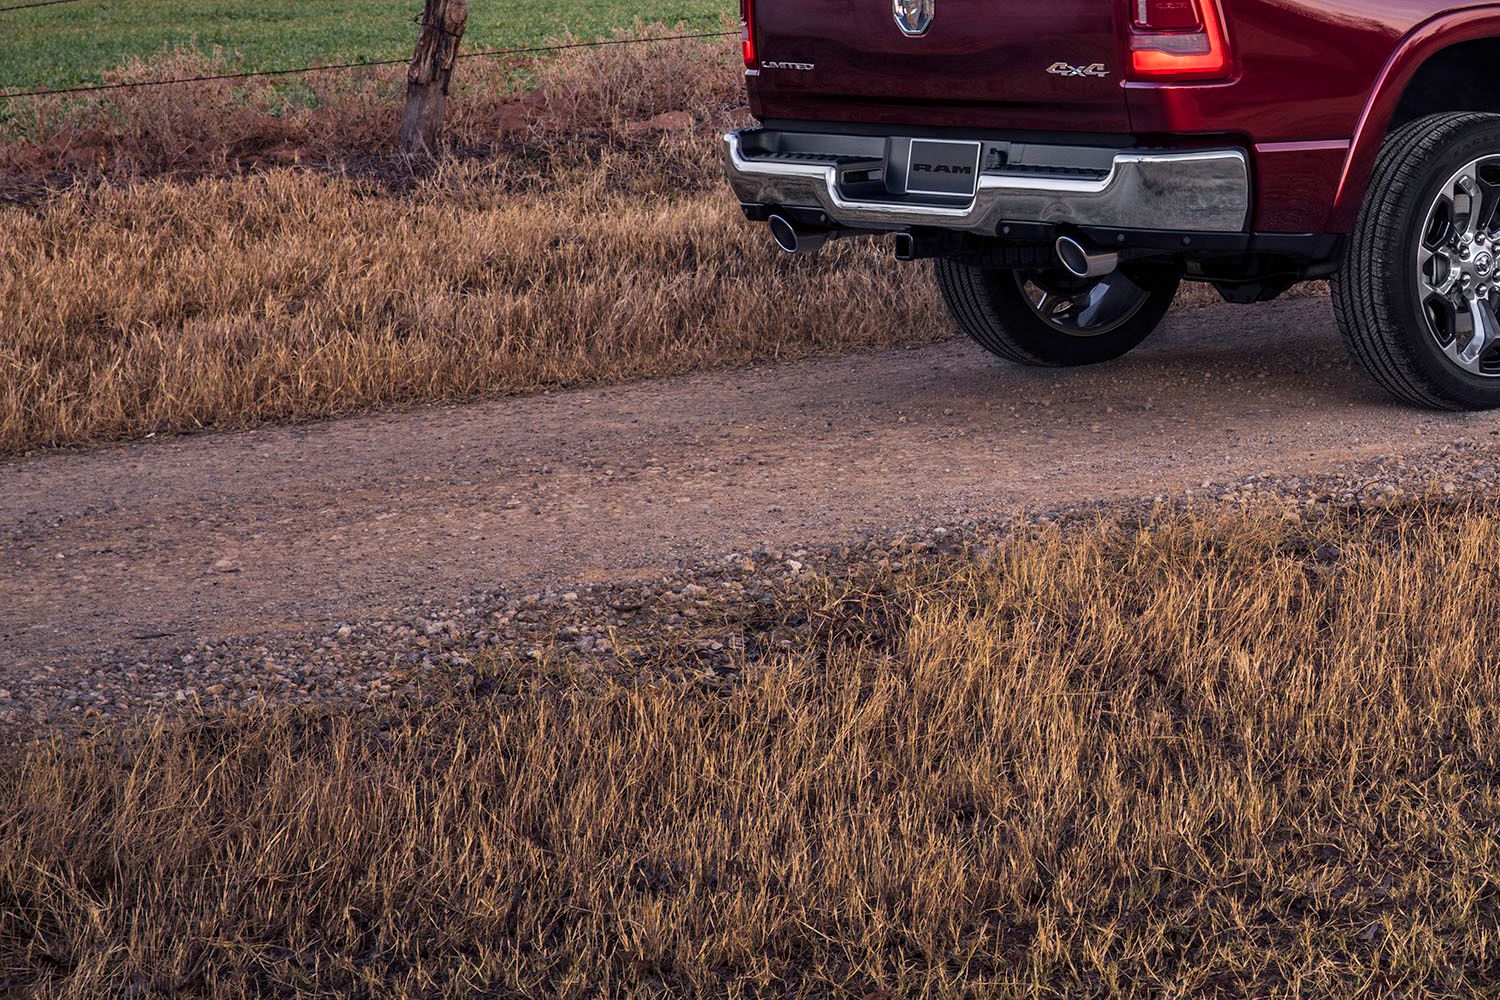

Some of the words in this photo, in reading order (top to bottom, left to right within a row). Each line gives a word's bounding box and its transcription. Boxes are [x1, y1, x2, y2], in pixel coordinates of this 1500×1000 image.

[761, 61, 815, 70] LIMITED
[1045, 62, 1110, 77] 4x4
[913, 164, 971, 174] RAM
